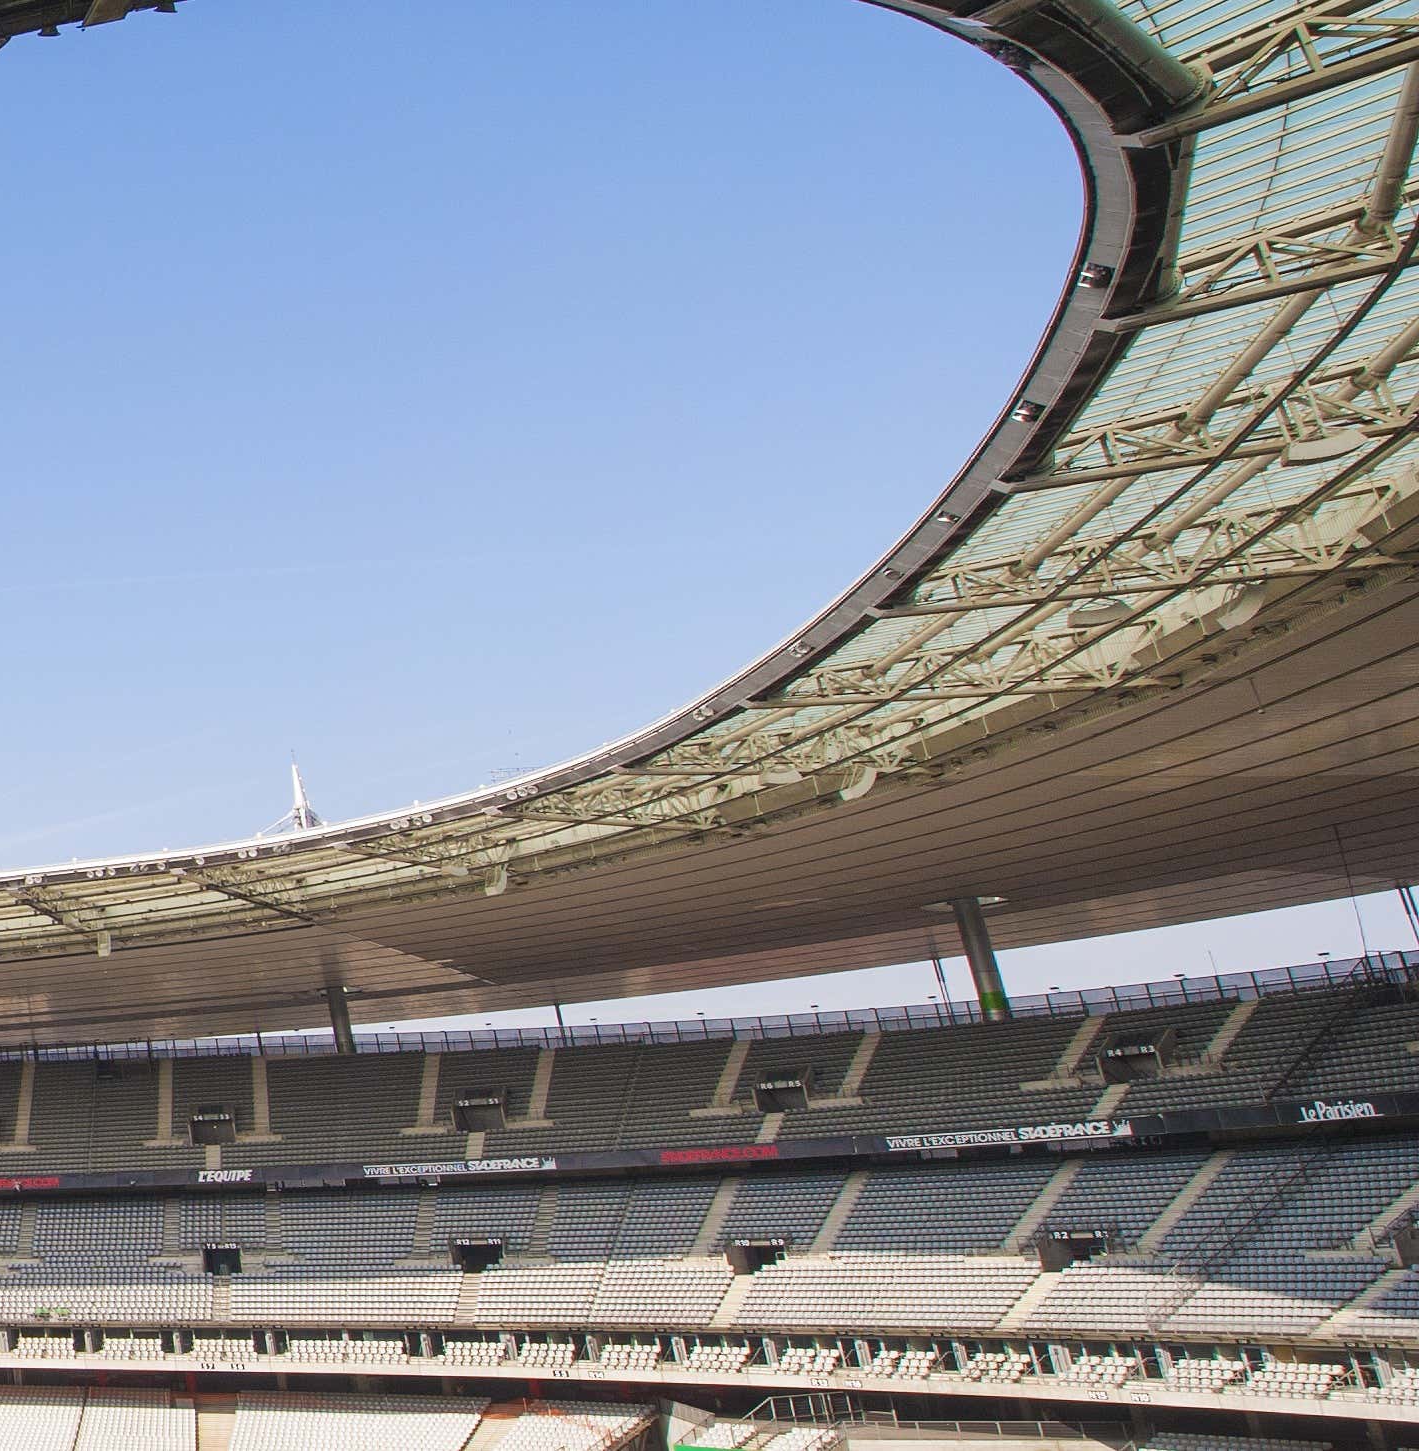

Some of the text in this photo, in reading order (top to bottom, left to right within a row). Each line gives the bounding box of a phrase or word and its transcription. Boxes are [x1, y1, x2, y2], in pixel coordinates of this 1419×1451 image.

[1140, 1045, 1156, 1054] R3
[1314, 1101, 1375, 1120] Parisien
[886, 1120, 1110, 1149] VIVRE L'EXCEPTIONNEL STADEFRANCE
[364, 1157, 540, 1175] VIVRE L'EXCEPTIONNEL STADEFRANCE
[198, 1169, 253, 1182] L'EQUIPE
